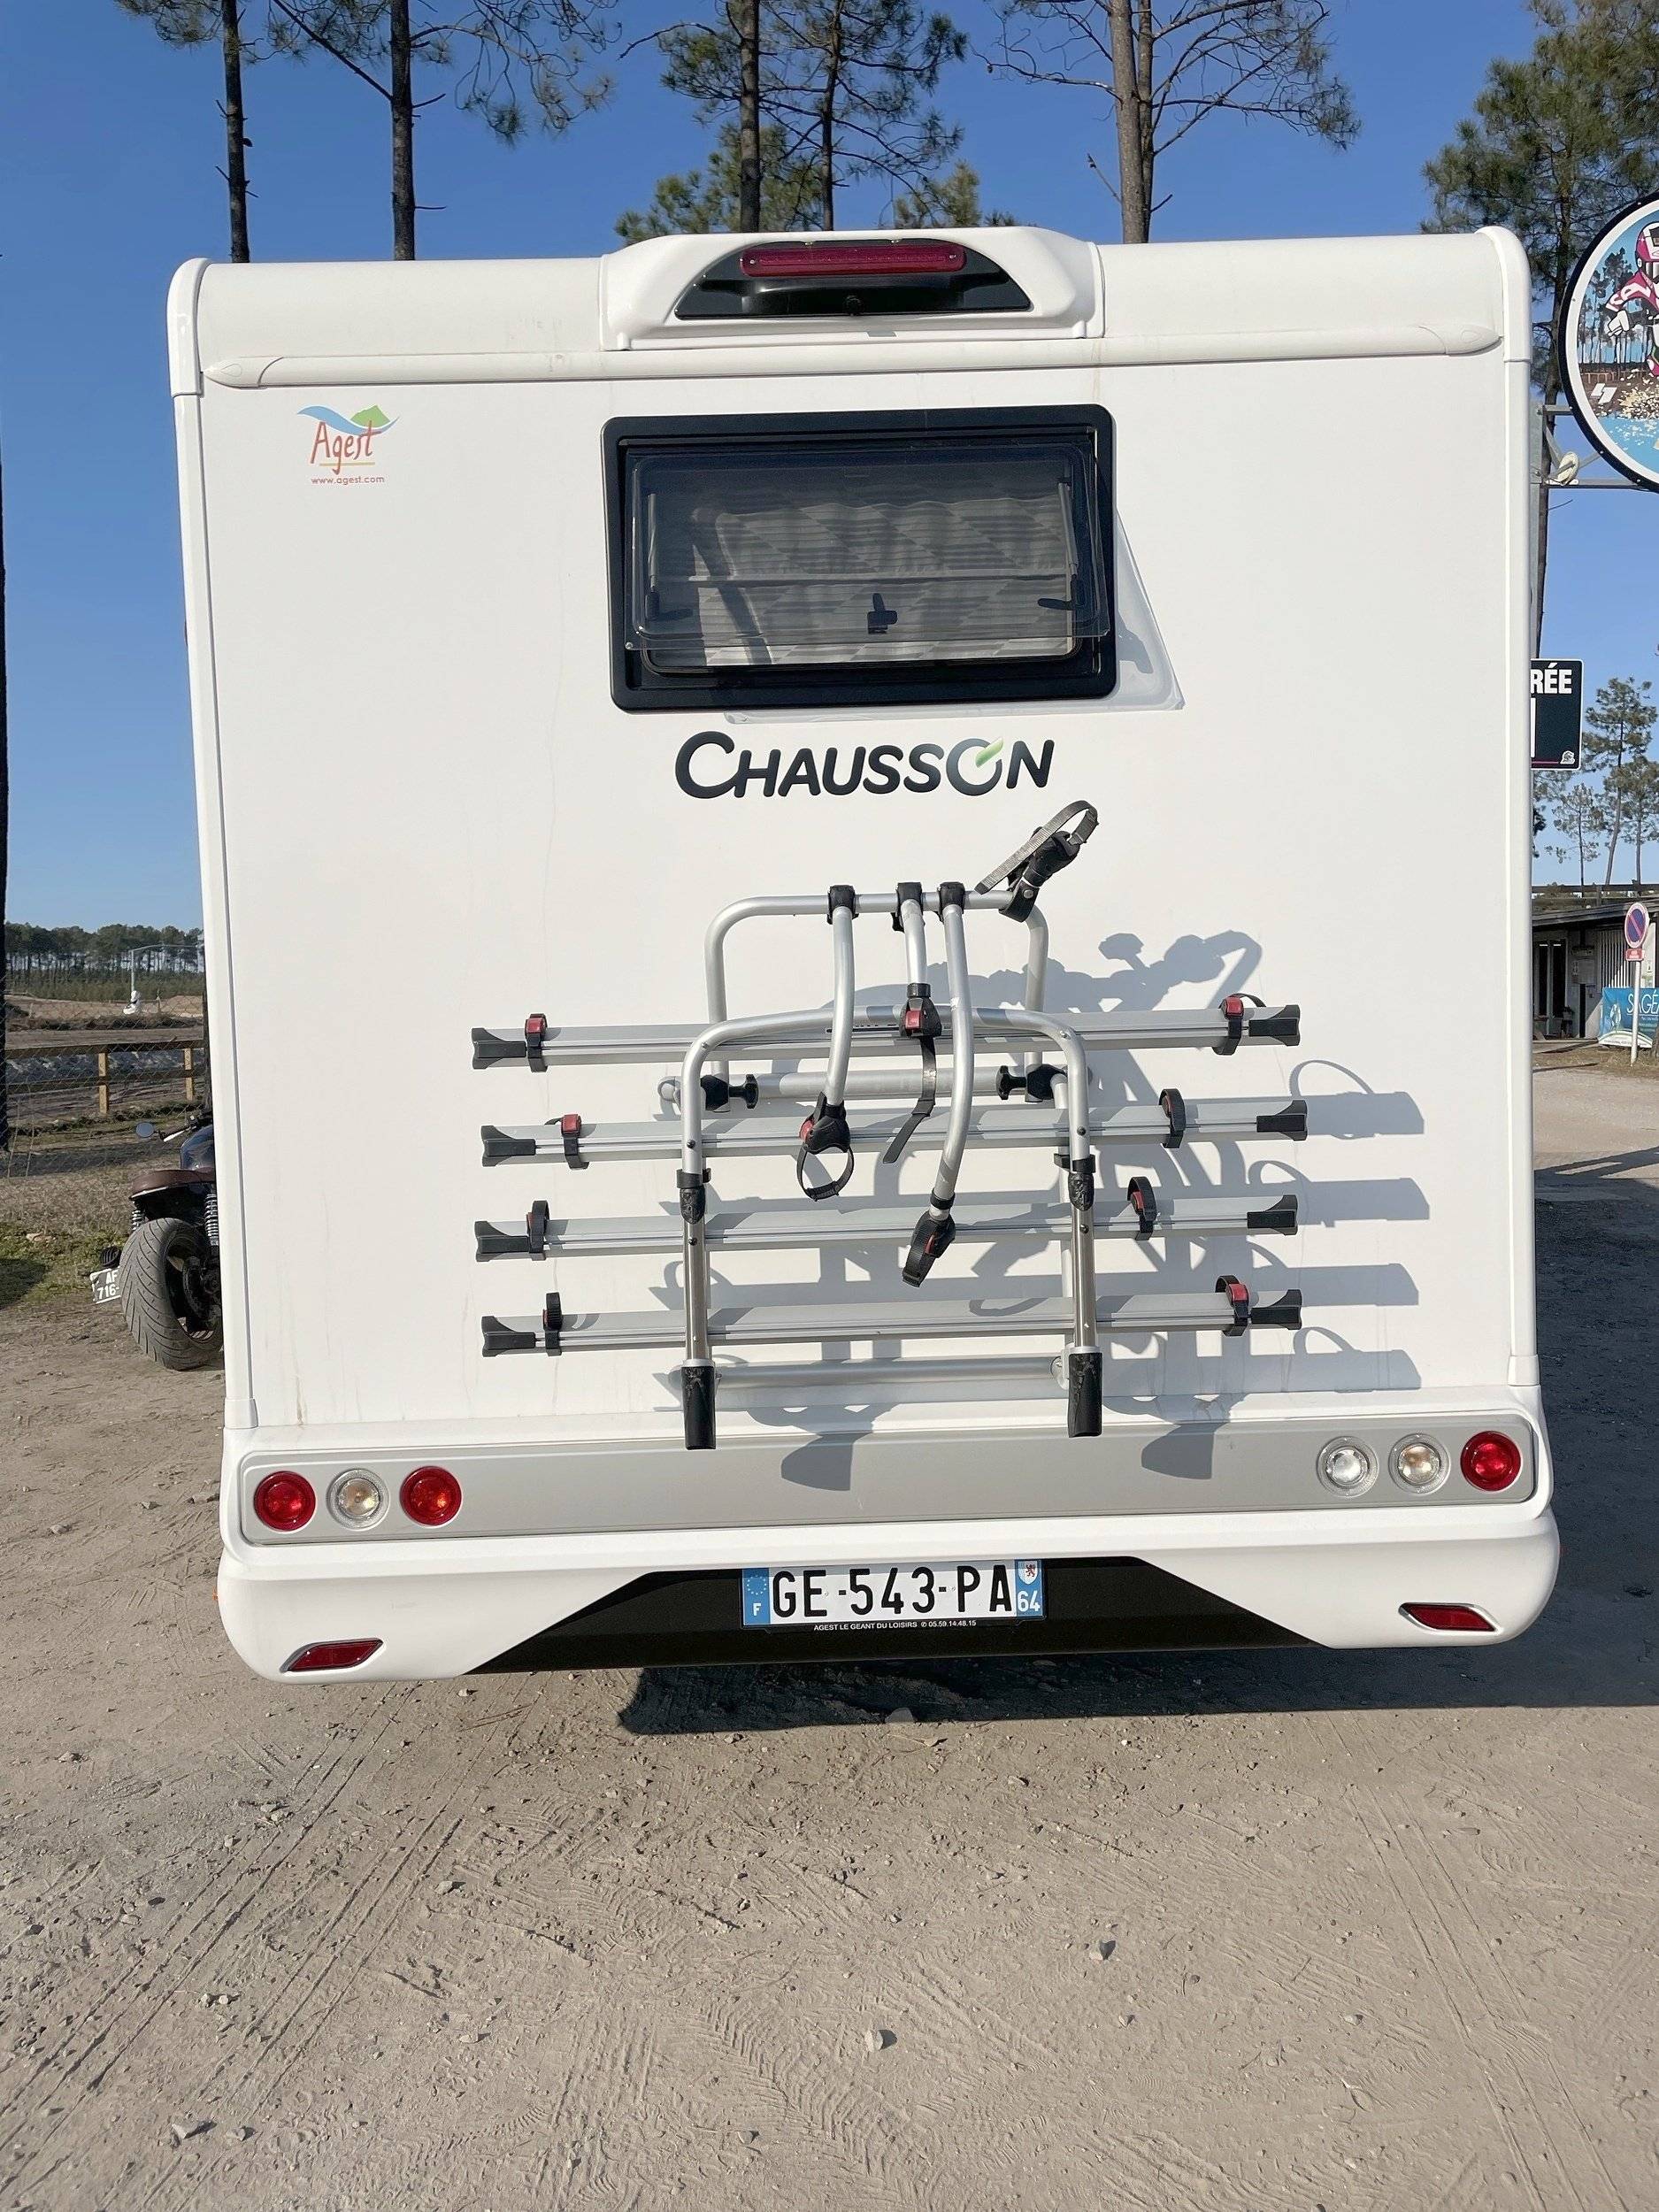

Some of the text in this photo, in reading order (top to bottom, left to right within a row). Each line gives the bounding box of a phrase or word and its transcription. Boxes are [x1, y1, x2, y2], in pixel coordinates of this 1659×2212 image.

[310, 420, 382, 475] Agest
[311, 476, 384, 486] www.agest.com
[772, 1564, 1012, 1617] GE-543-PA
[1017, 1590, 1041, 1612] 64
[753, 1602, 762, 1617] F
